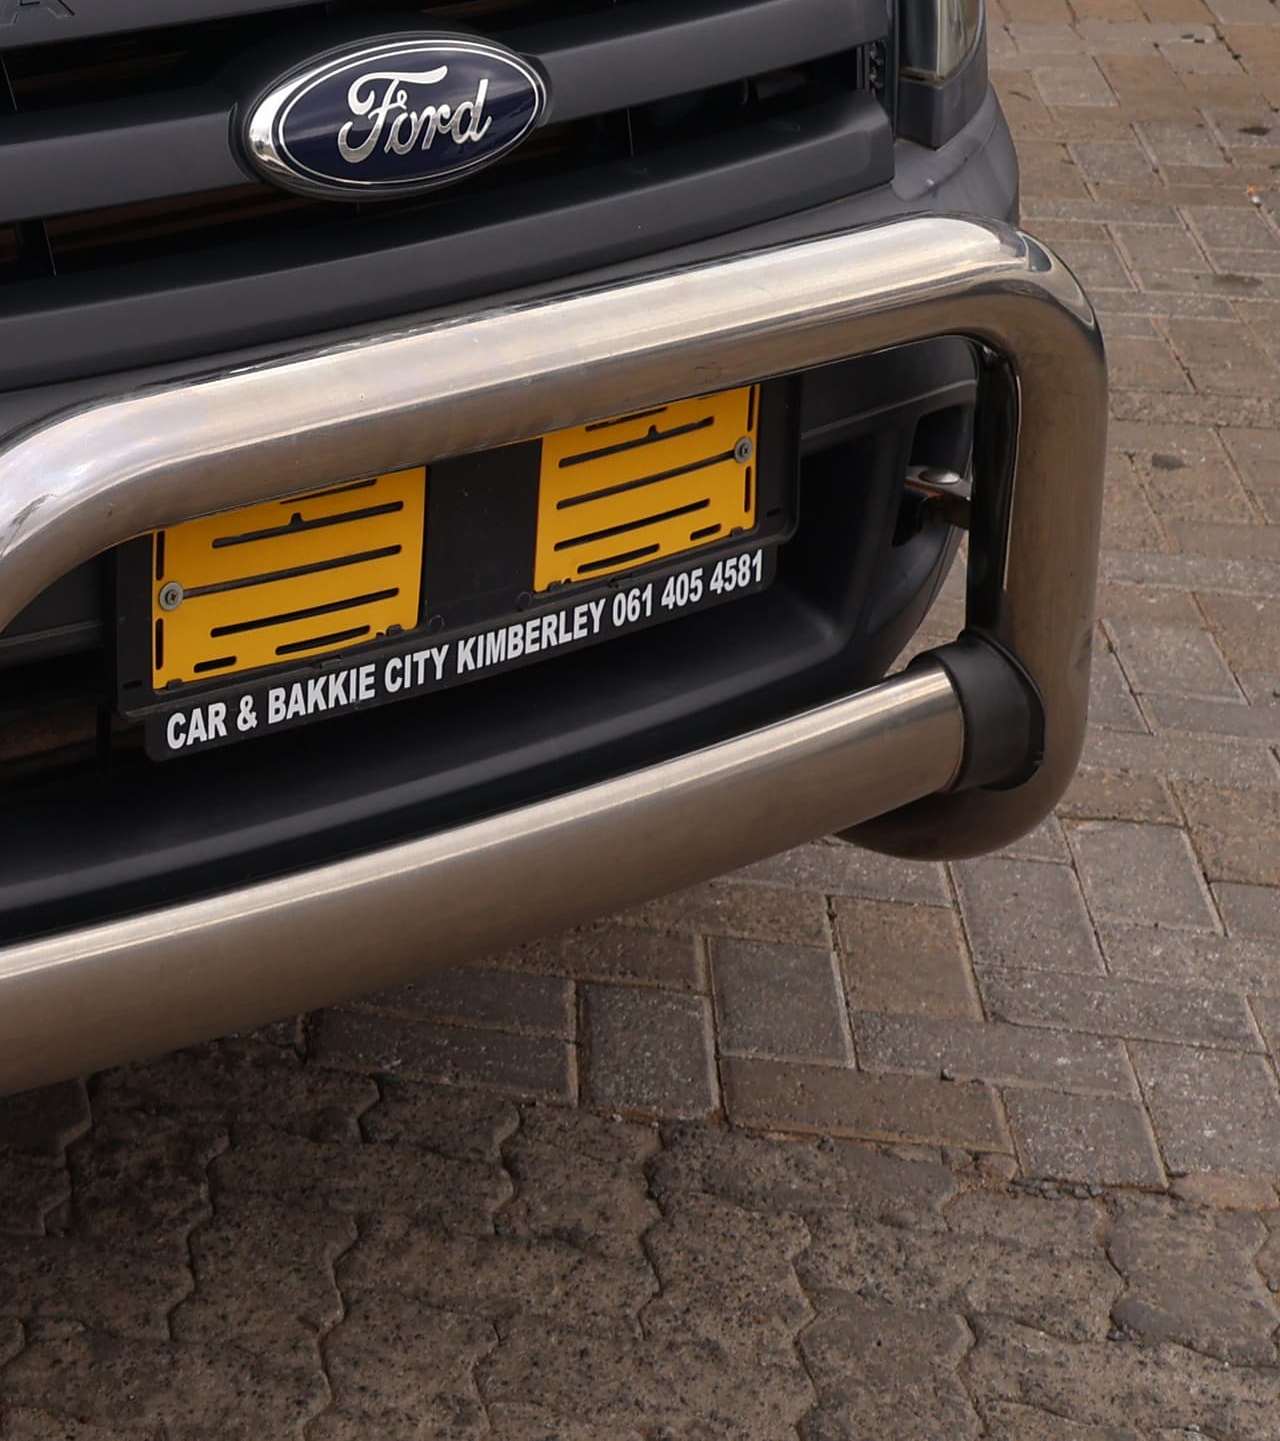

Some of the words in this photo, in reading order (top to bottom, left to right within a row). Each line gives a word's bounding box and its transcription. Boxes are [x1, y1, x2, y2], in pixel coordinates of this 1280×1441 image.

[337, 65, 492, 163] Ford
[166, 702, 228, 750] CAR
[236, 695, 258, 731] &
[268, 663, 376, 724] BAKKIE
[384, 644, 450, 693] CITY
[456, 598, 606, 674] KIMBERLEY
[612, 583, 653, 626] 061
[661, 568, 703, 610] 405
[710, 549, 763, 594] 4581
